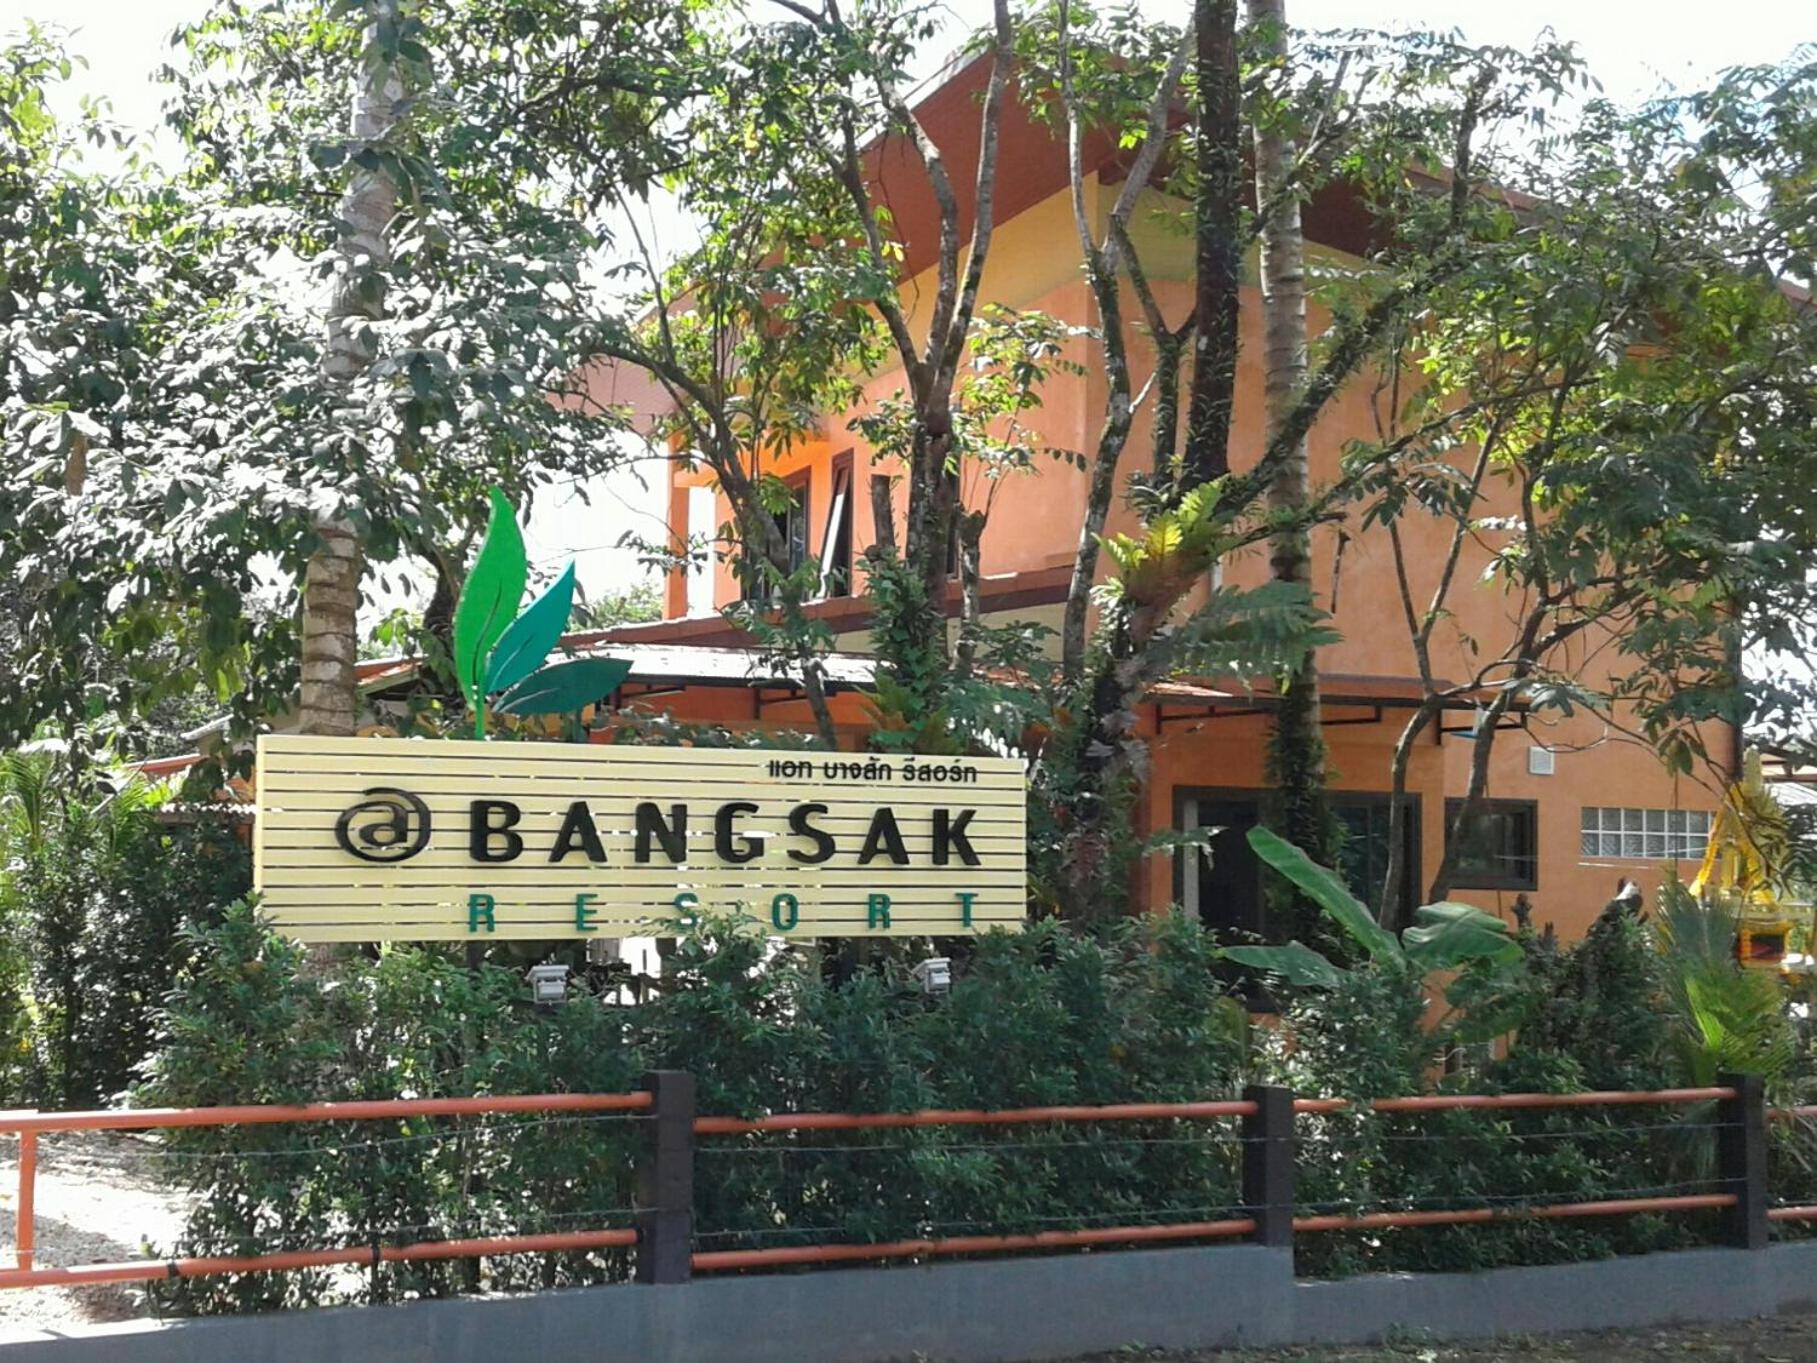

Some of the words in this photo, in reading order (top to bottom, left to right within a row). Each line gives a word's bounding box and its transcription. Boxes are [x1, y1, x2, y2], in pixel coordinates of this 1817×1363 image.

[824, 757, 891, 780] บางสัก
[902, 758, 977, 783] รีสอร์ท
[468, 893, 979, 934] RESORT
